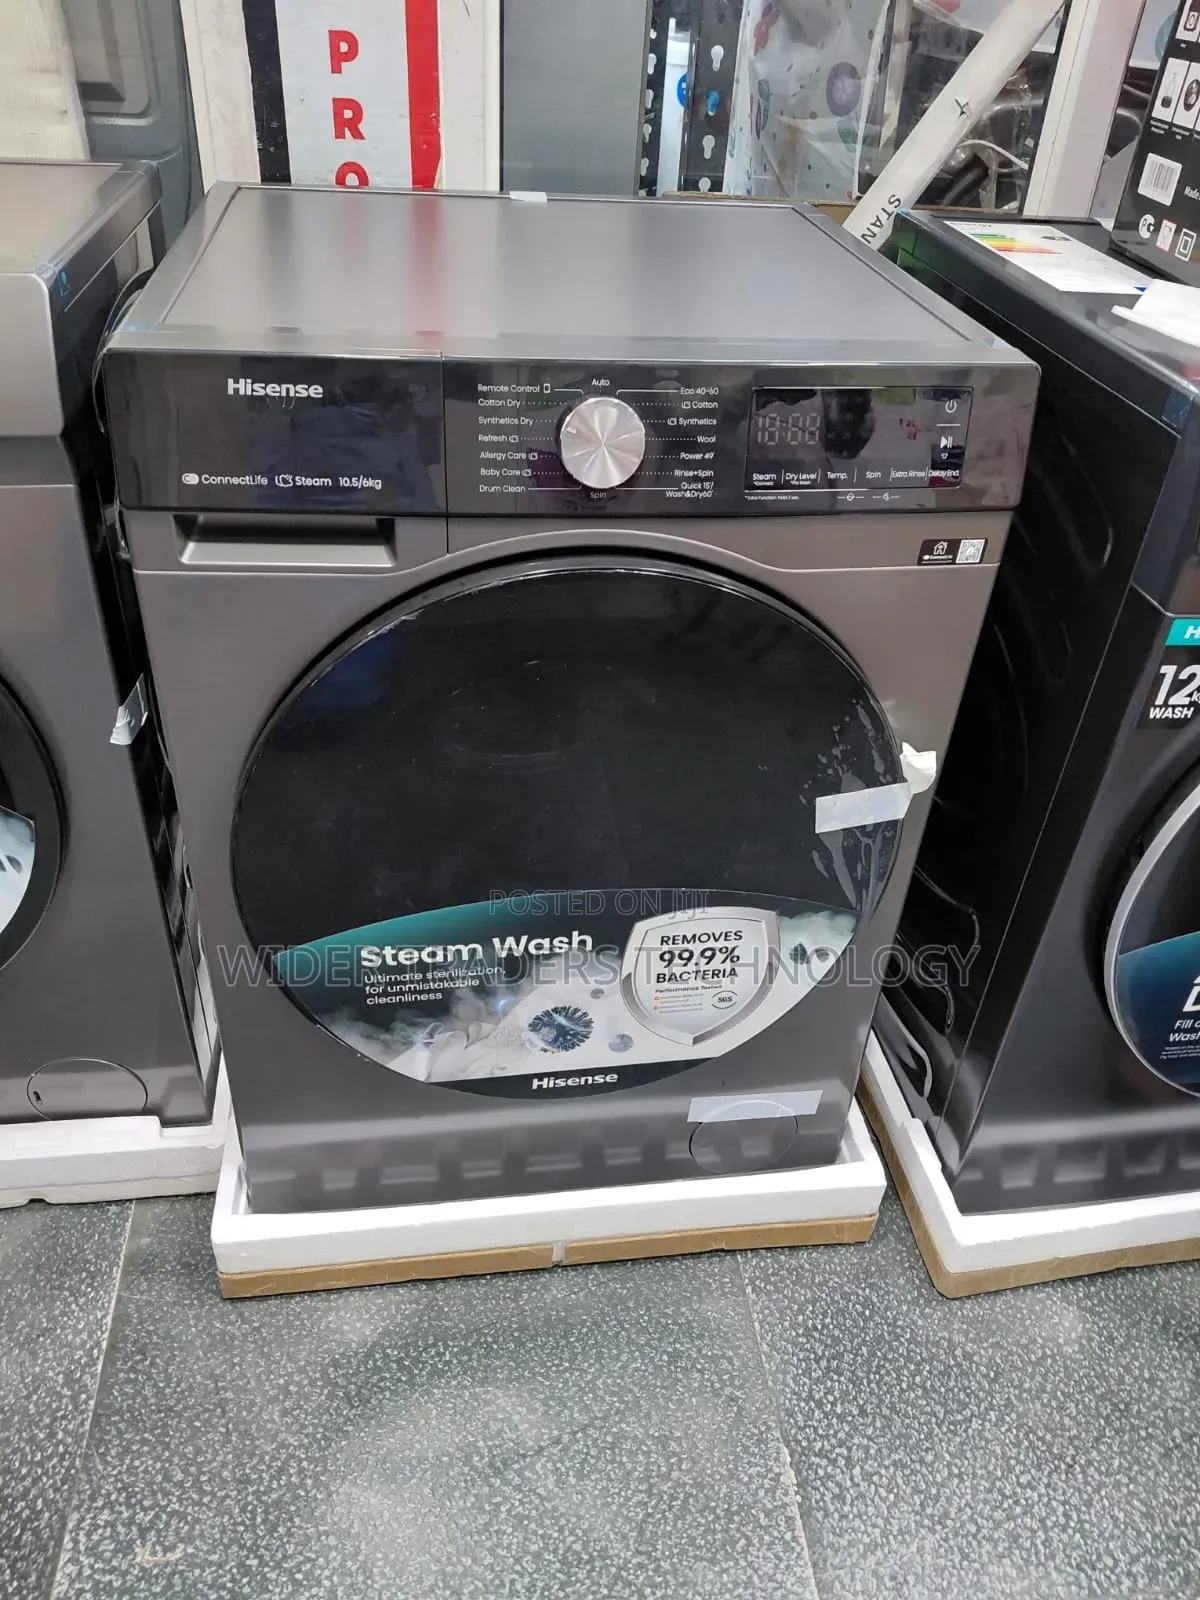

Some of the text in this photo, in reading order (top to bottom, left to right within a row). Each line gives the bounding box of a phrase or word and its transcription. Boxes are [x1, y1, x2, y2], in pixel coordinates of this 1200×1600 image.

[861, 194, 902, 244] STAN
[591, 378, 610, 386] Auto
[227, 378, 324, 398] Hisense
[478, 384, 540, 393] Remote Control
[680, 387, 719, 396] Eco 40-60
[478, 398, 521, 409] Cotton Dry
[692, 401, 718, 409] Cotton
[478, 416, 534, 427] Synthetics Dry
[679, 417, 717, 426] Synthetics
[478, 433, 507, 442] Refresh
[697, 435, 716, 443] Wool
[480, 451, 526, 461] Allergy Care
[680, 451, 702, 460] Power
[480, 468, 521, 477] Baby Care
[674, 469, 714, 478] Rinse+Spin
[752, 469, 960, 482] Steam Dry Level Temp. Spin Extra Rinse Delay End
[201, 473, 382, 490] ConnectLife Steam 10.5/6kg
[681, 482, 702, 490] Quick
[479, 484, 526, 493] Drum Clean
[590, 491, 606, 499] Spin
[1149, 706, 1195, 719] WASH
[660, 929, 744, 946] REMOVES
[361, 930, 593, 968] Steam Wash
[658, 944, 741, 969] 99.9%
[364, 972, 423, 985] Ultimate
[656, 967, 739, 984] BACTERIA
[365, 978, 481, 996] for unmistakable
[366, 991, 443, 1006] cleanliness
[1174, 1019, 1194, 1030] Fill
[532, 1073, 619, 1090] Hisense
